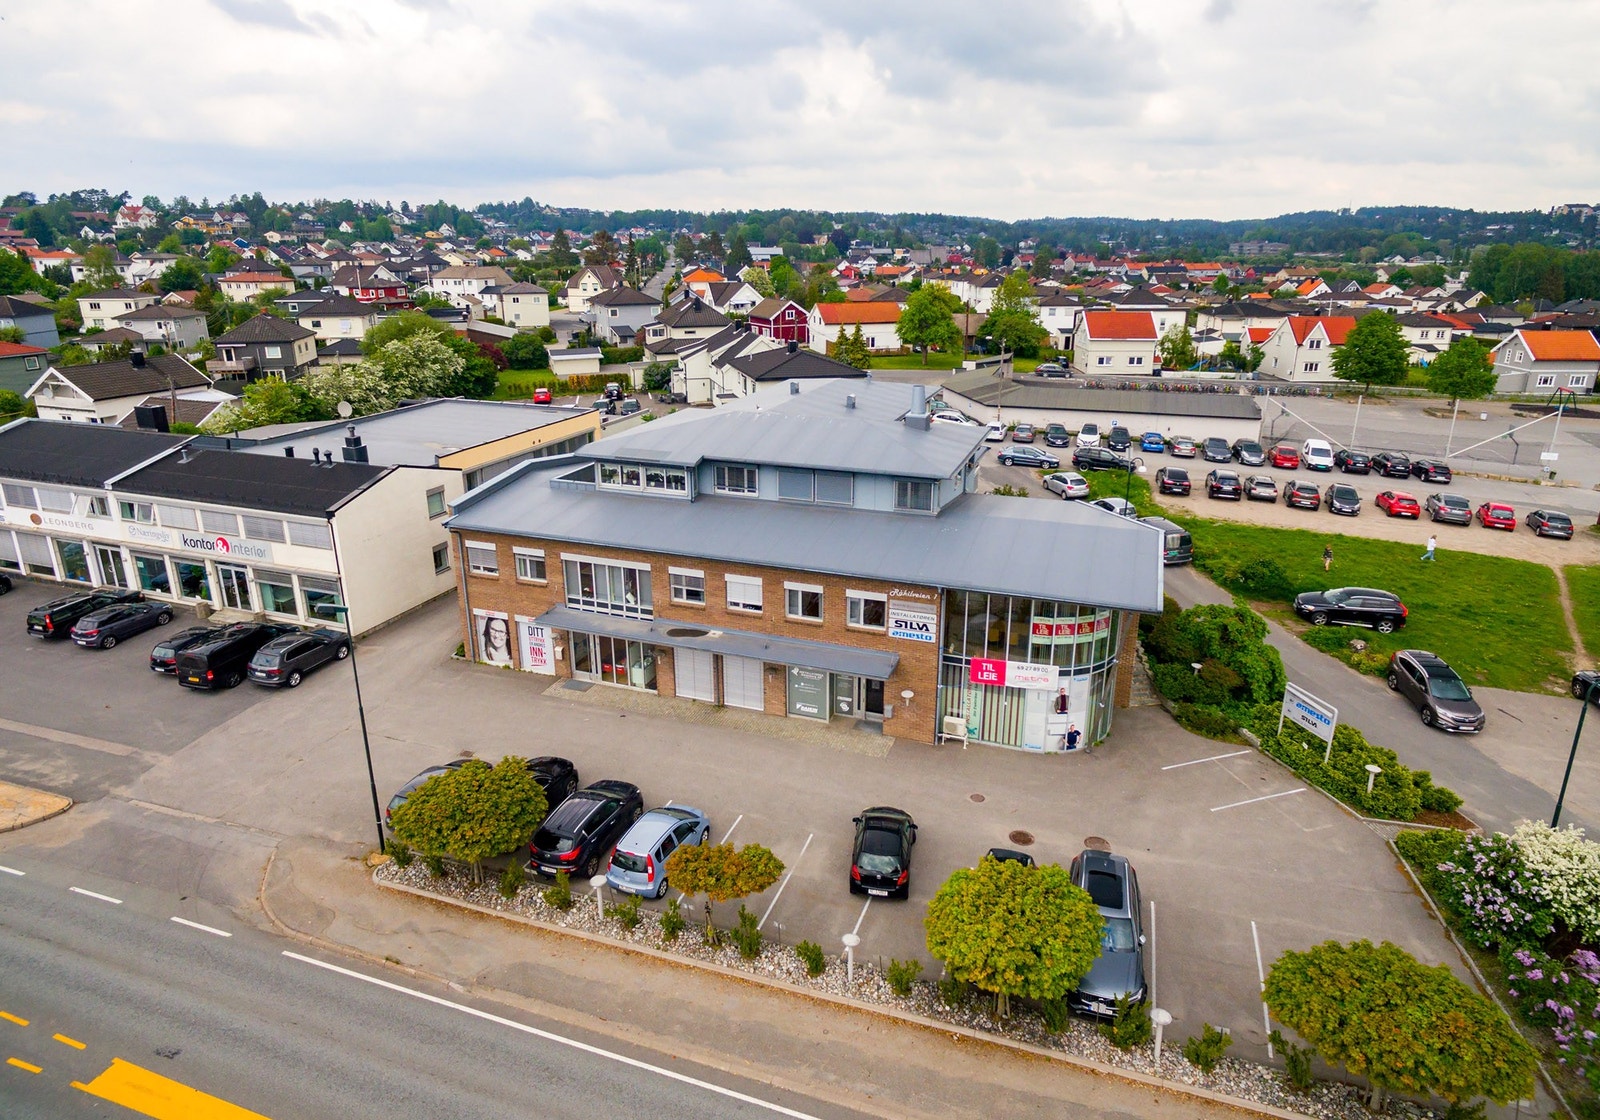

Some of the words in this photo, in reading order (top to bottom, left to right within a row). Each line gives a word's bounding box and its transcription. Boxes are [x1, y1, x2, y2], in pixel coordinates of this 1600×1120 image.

[44, 518, 94, 531] LEONBERG
[182, 534, 215, 551] kontor
[528, 626, 544, 638] DITT
[894, 620, 930, 632] SILVA
[530, 646, 547, 657] INN-
[982, 663, 995, 672] TIL
[978, 671, 998, 681] LEIE
